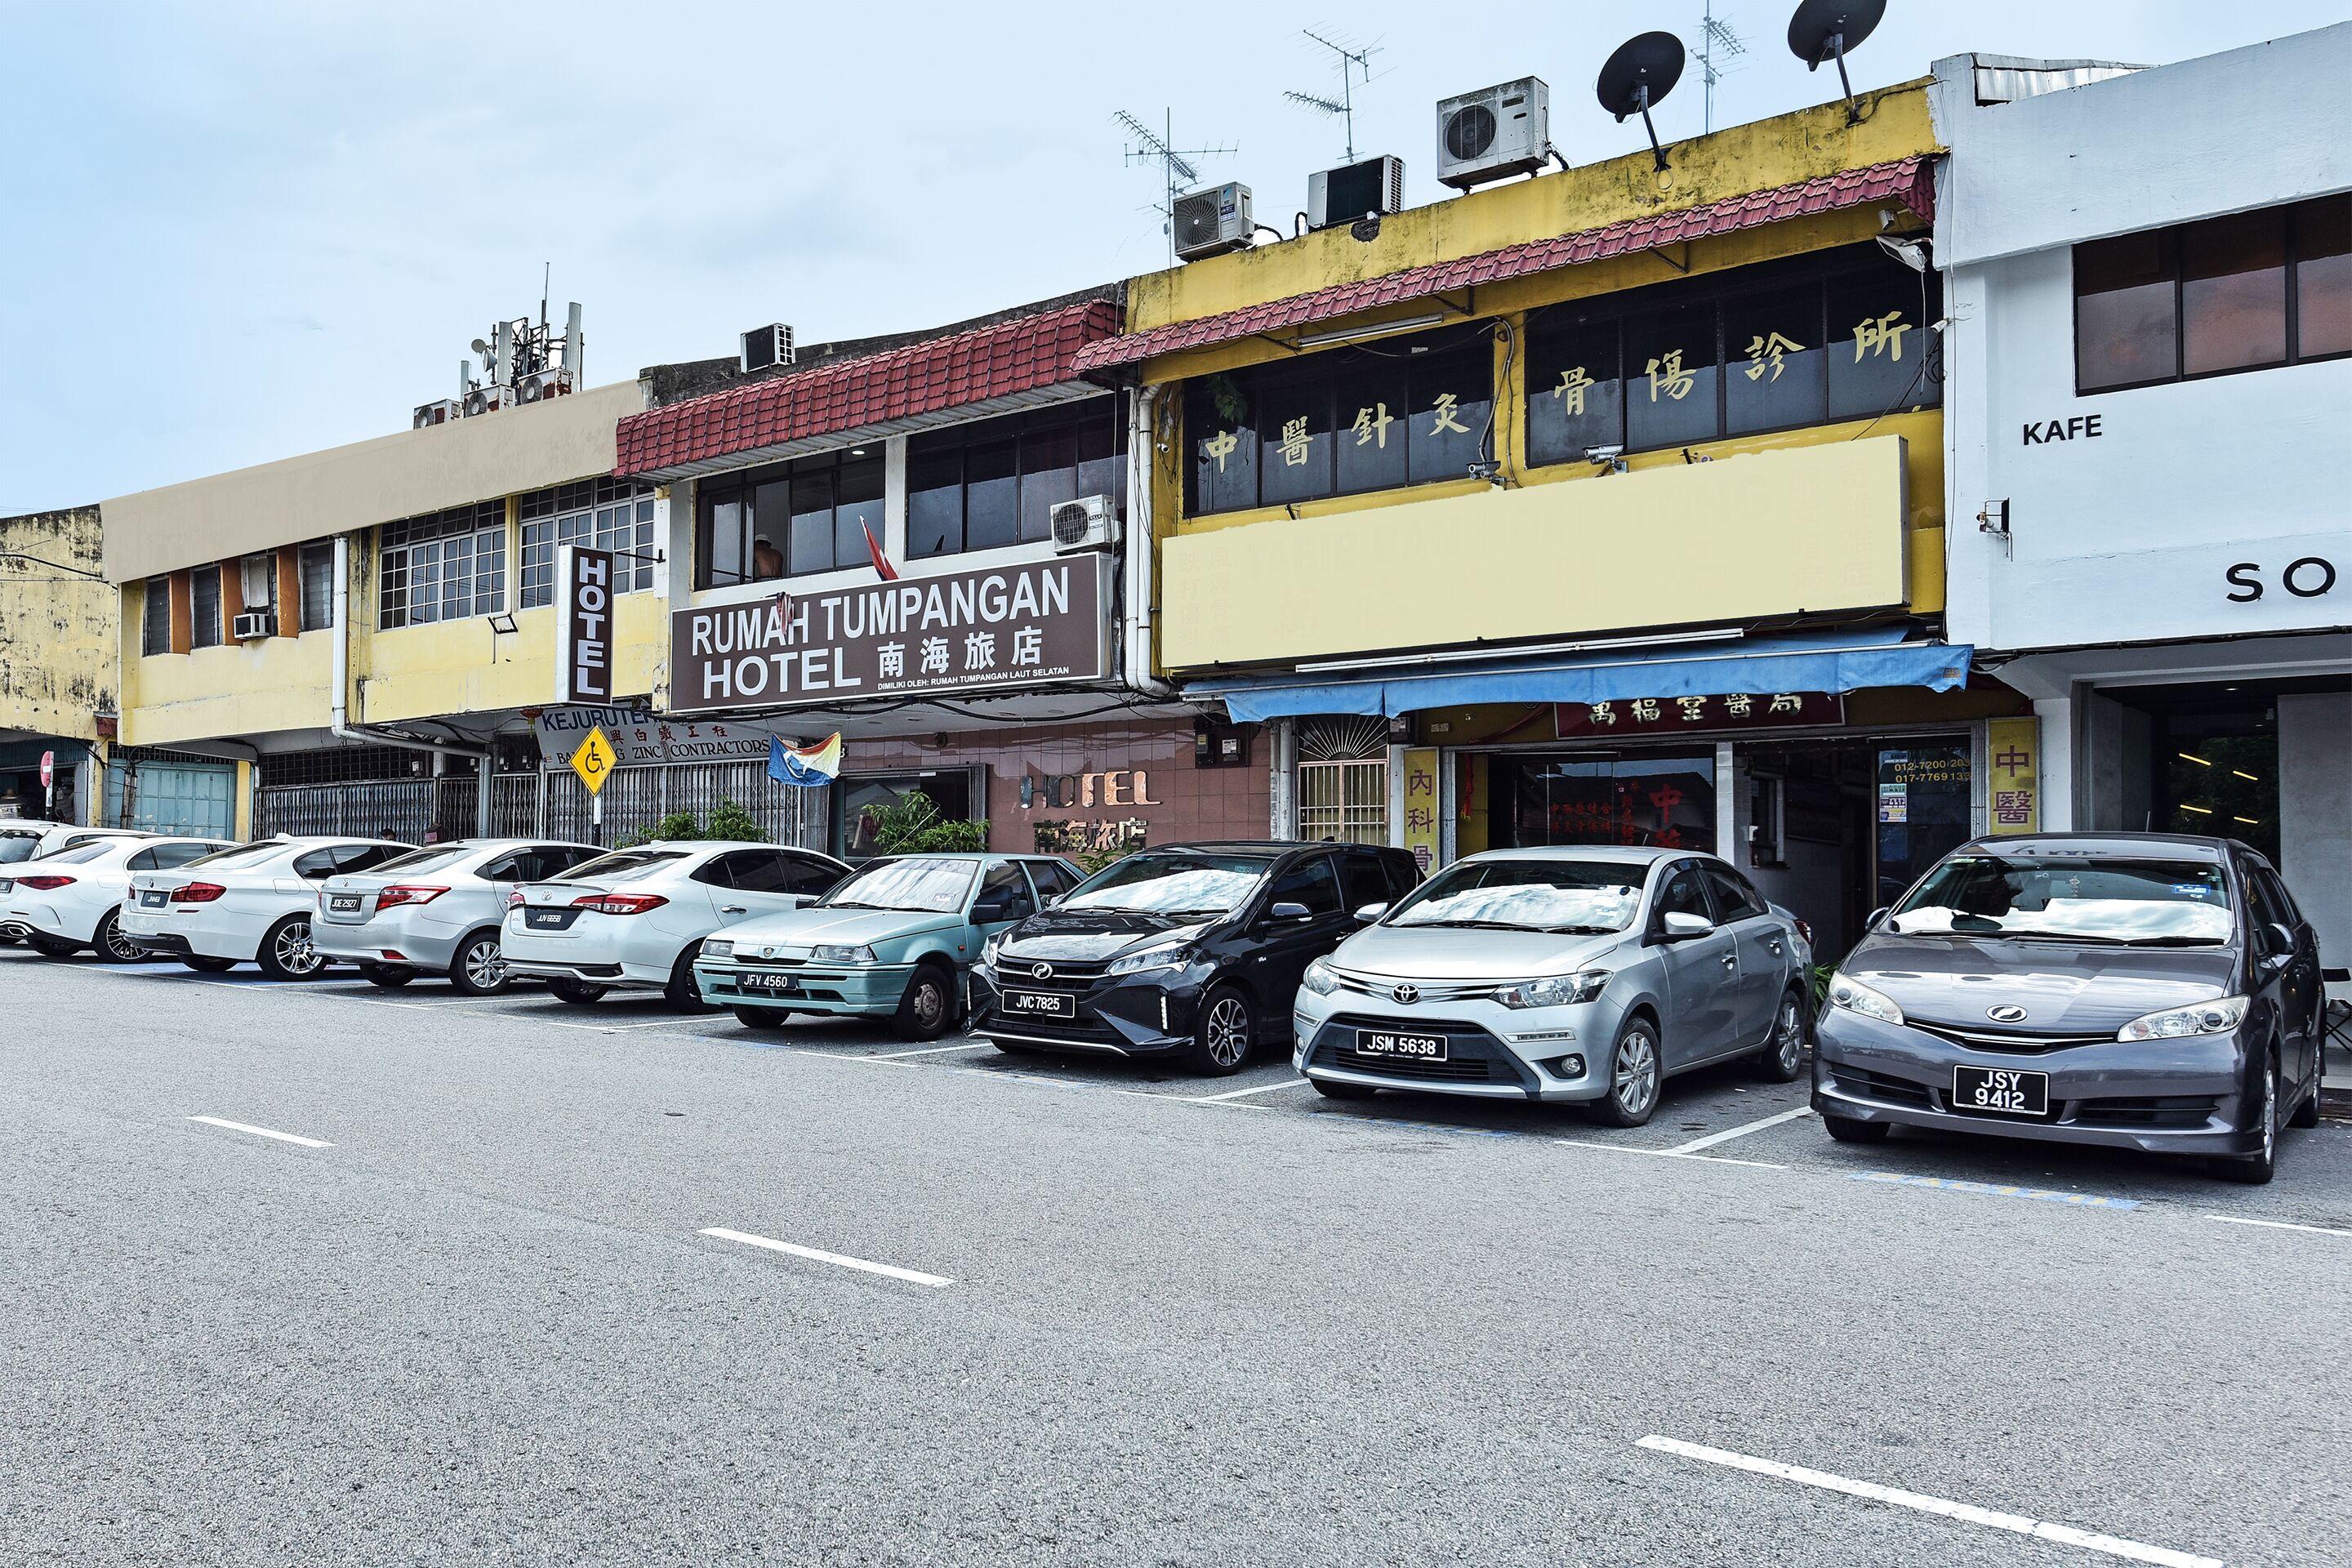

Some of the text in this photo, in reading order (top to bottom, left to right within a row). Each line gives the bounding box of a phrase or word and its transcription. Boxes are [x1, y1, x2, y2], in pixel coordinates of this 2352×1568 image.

[2023, 413, 2103, 446] KAFE
[692, 566, 1069, 656] RUMAH TUMPANGAN
[577, 556, 607, 696] HOTEL
[876, 625, 1043, 679] 南海旅店
[703, 646, 862, 699] HOTEL
[877, 666, 1070, 691] DIMILIKI OLEH: RUMAH TUMPANGAN LAUT SELATAN
[631, 745, 663, 759] ZINC
[670, 739, 771, 757] CONTRACTORS
[1020, 769, 1162, 808] HOTEL
[1895, 772, 1948, 783] 017-7769
[1993, 745, 2033, 824] 中醫
[1032, 817, 1148, 853] 南海旅店
[743, 973, 788, 987] JFV 4560
[1016, 995, 1060, 1010] JVC 7825
[1366, 1035, 1437, 1055] JSM 5638
[1980, 1071, 2021, 1091] JSY
[1975, 1088, 2025, 1110] 9412
